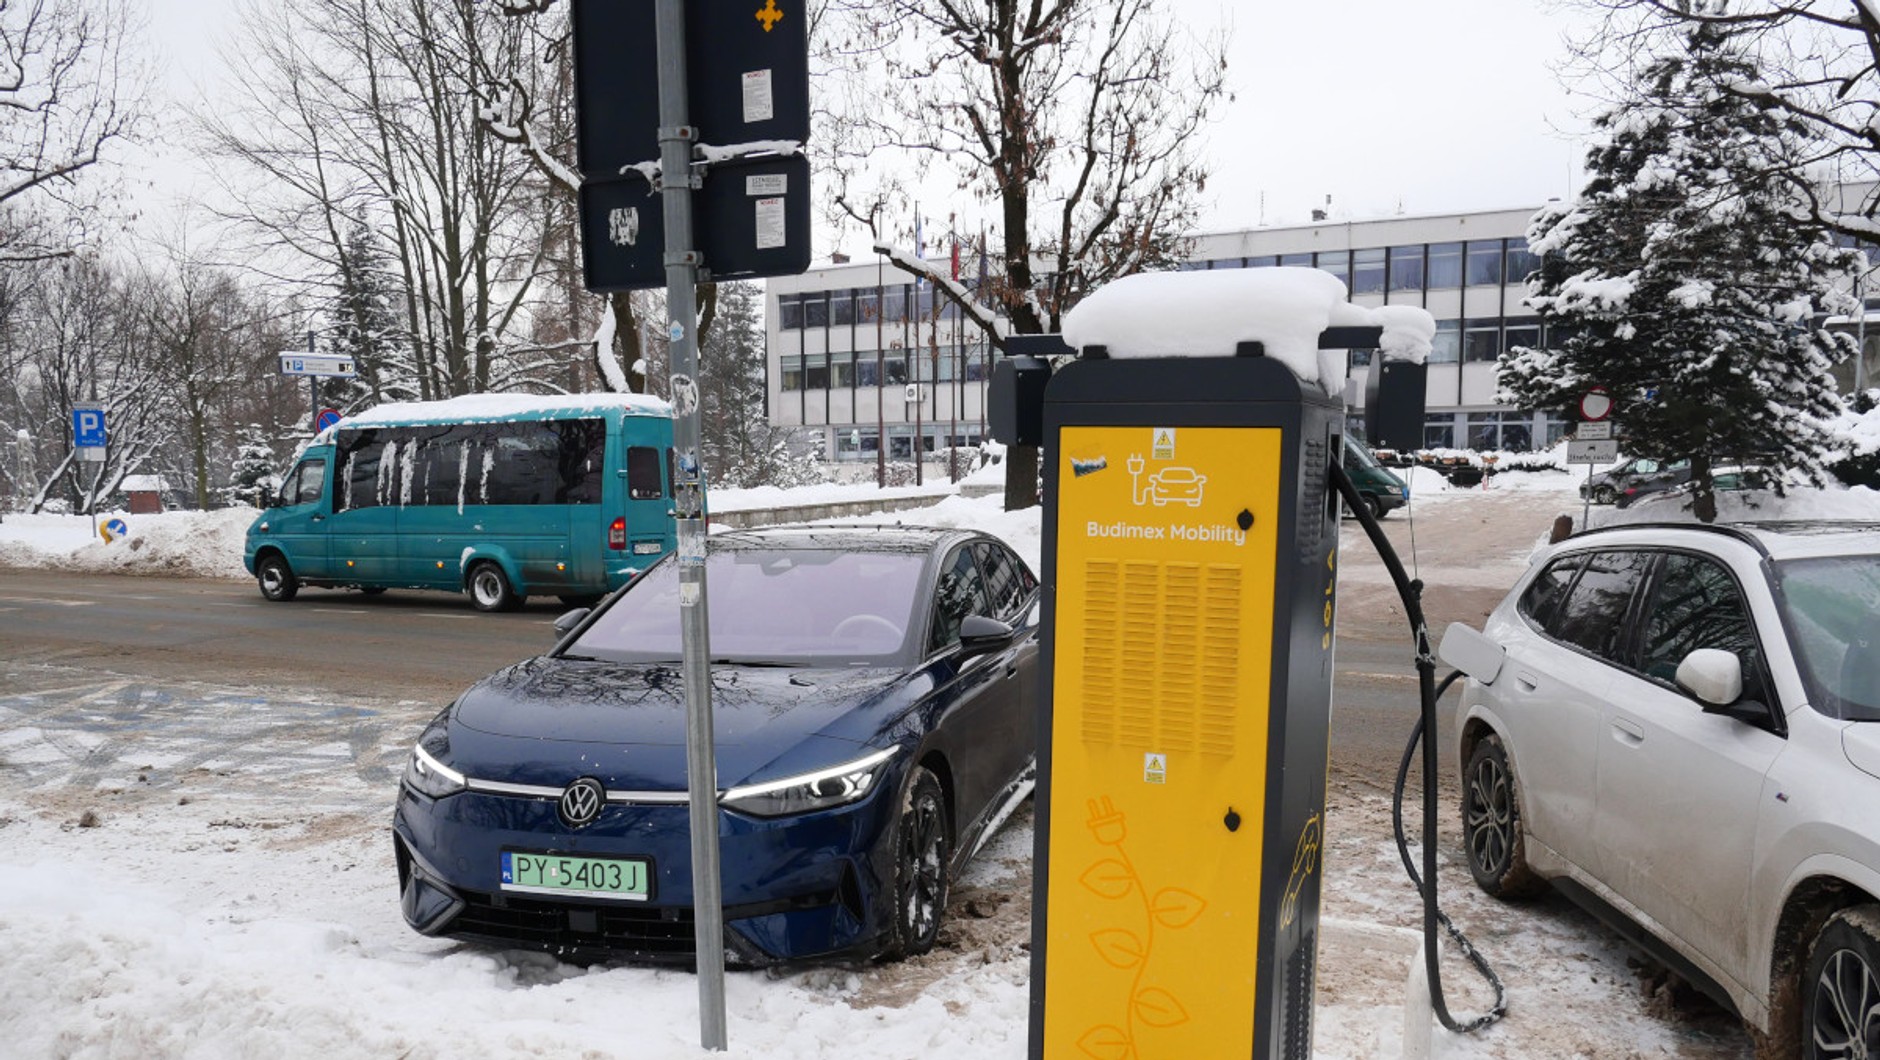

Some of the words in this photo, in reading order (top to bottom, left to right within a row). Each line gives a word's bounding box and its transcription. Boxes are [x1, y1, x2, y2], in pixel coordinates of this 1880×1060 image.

[80, 412, 99, 437] P
[1087, 521, 1165, 539] Budimex
[1170, 523, 1246, 546] Mobility
[517, 856, 548, 885] PY
[559, 860, 637, 891] 5403J
